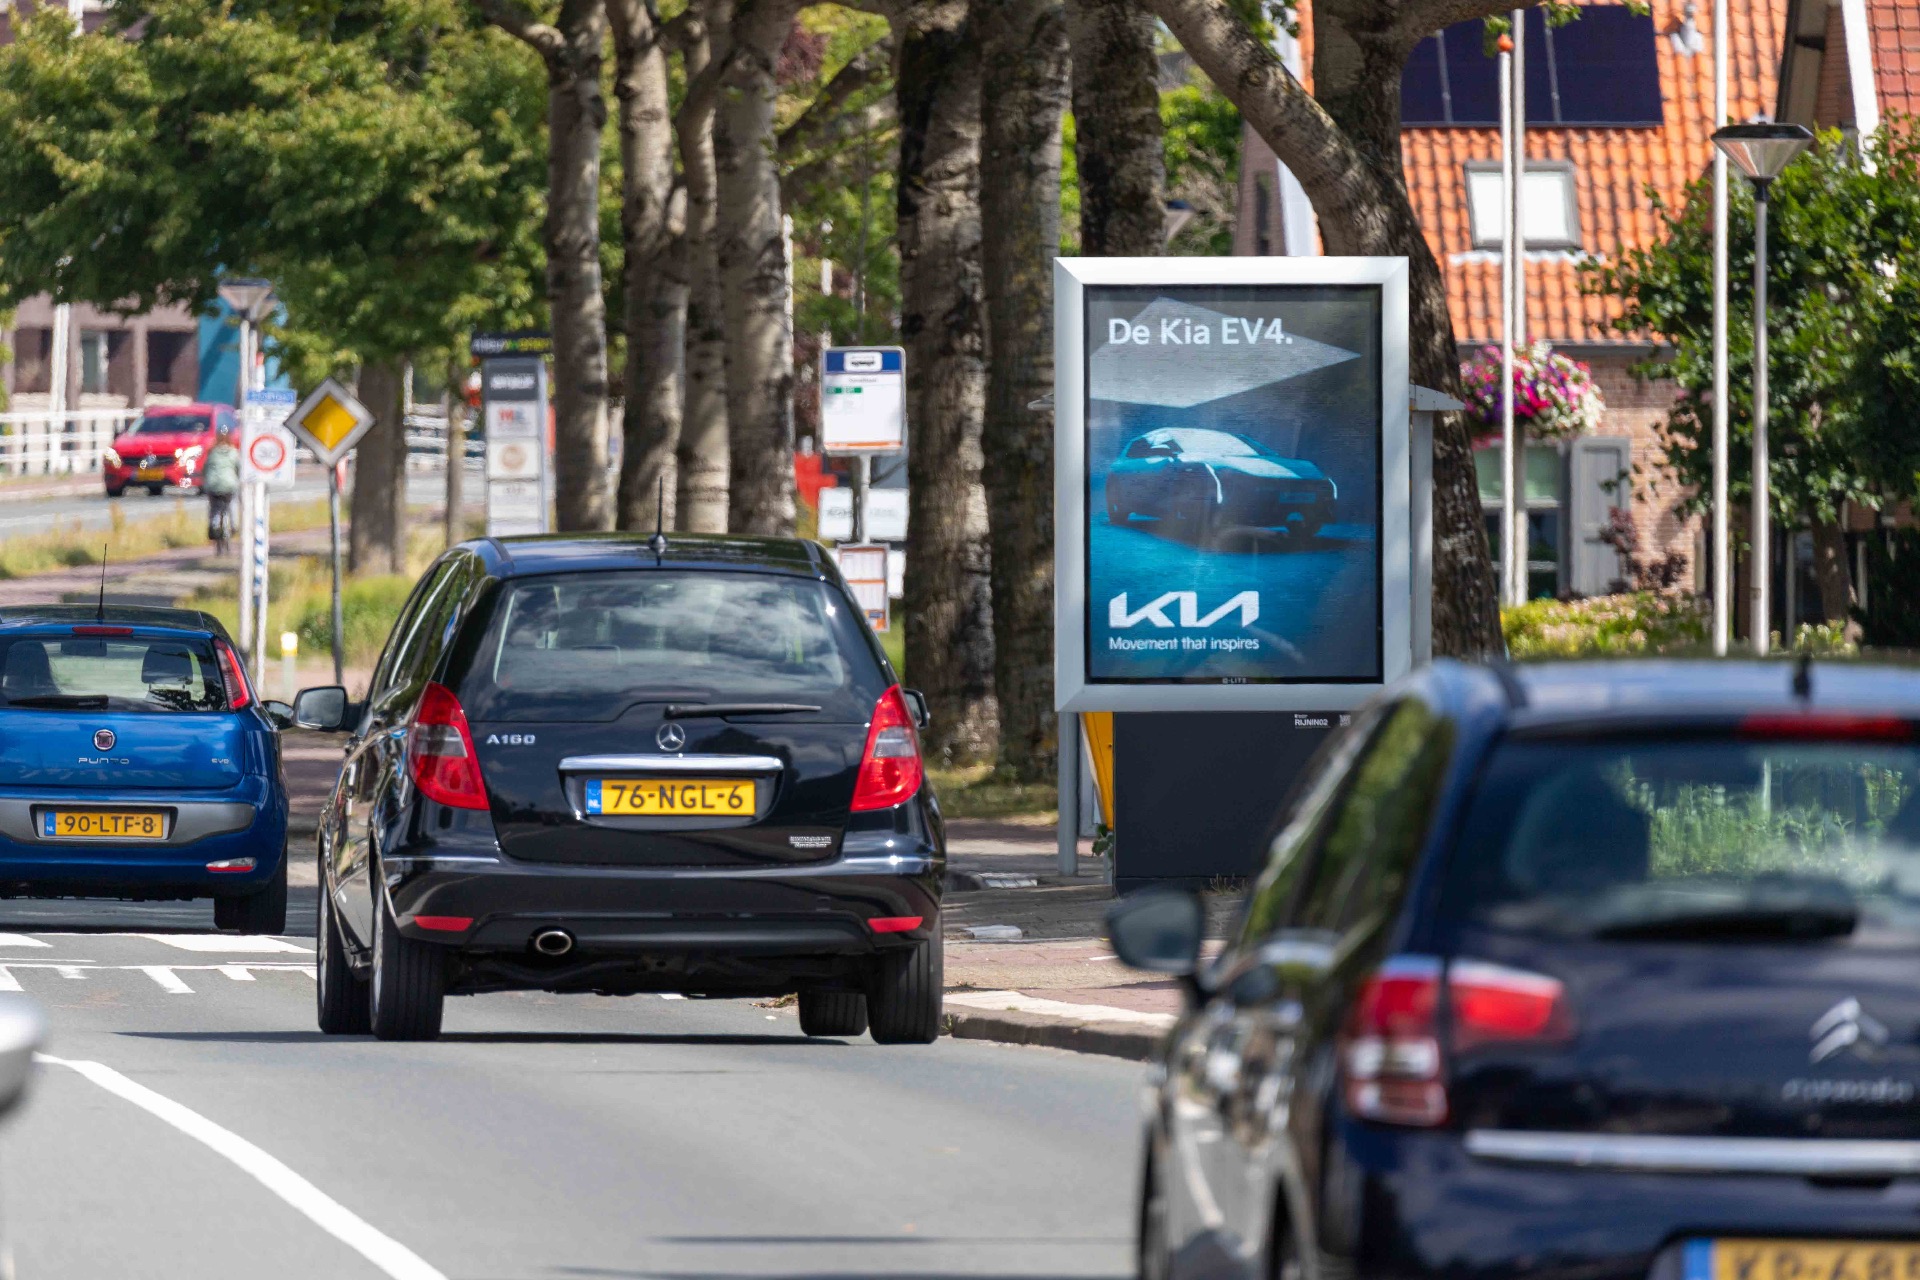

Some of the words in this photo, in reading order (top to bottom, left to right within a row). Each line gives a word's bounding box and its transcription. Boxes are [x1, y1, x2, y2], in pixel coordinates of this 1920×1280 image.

[1108, 317, 1150, 346] De
[1160, 317, 1211, 346] Kia
[1221, 317, 1294, 346] EV4.
[1109, 590, 1260, 628] KIA
[1109, 636, 1178, 651] Movement
[1182, 636, 1207, 651] that
[1211, 636, 1260, 653] inspires
[486, 733, 536, 745] A160
[78, 757, 130, 765] PUNTO
[588, 799, 601, 809] NL
[610, 784, 744, 810] 76-NGL-6
[46, 825, 55, 833] NL
[64, 815, 155, 834] 90-LTF-8
